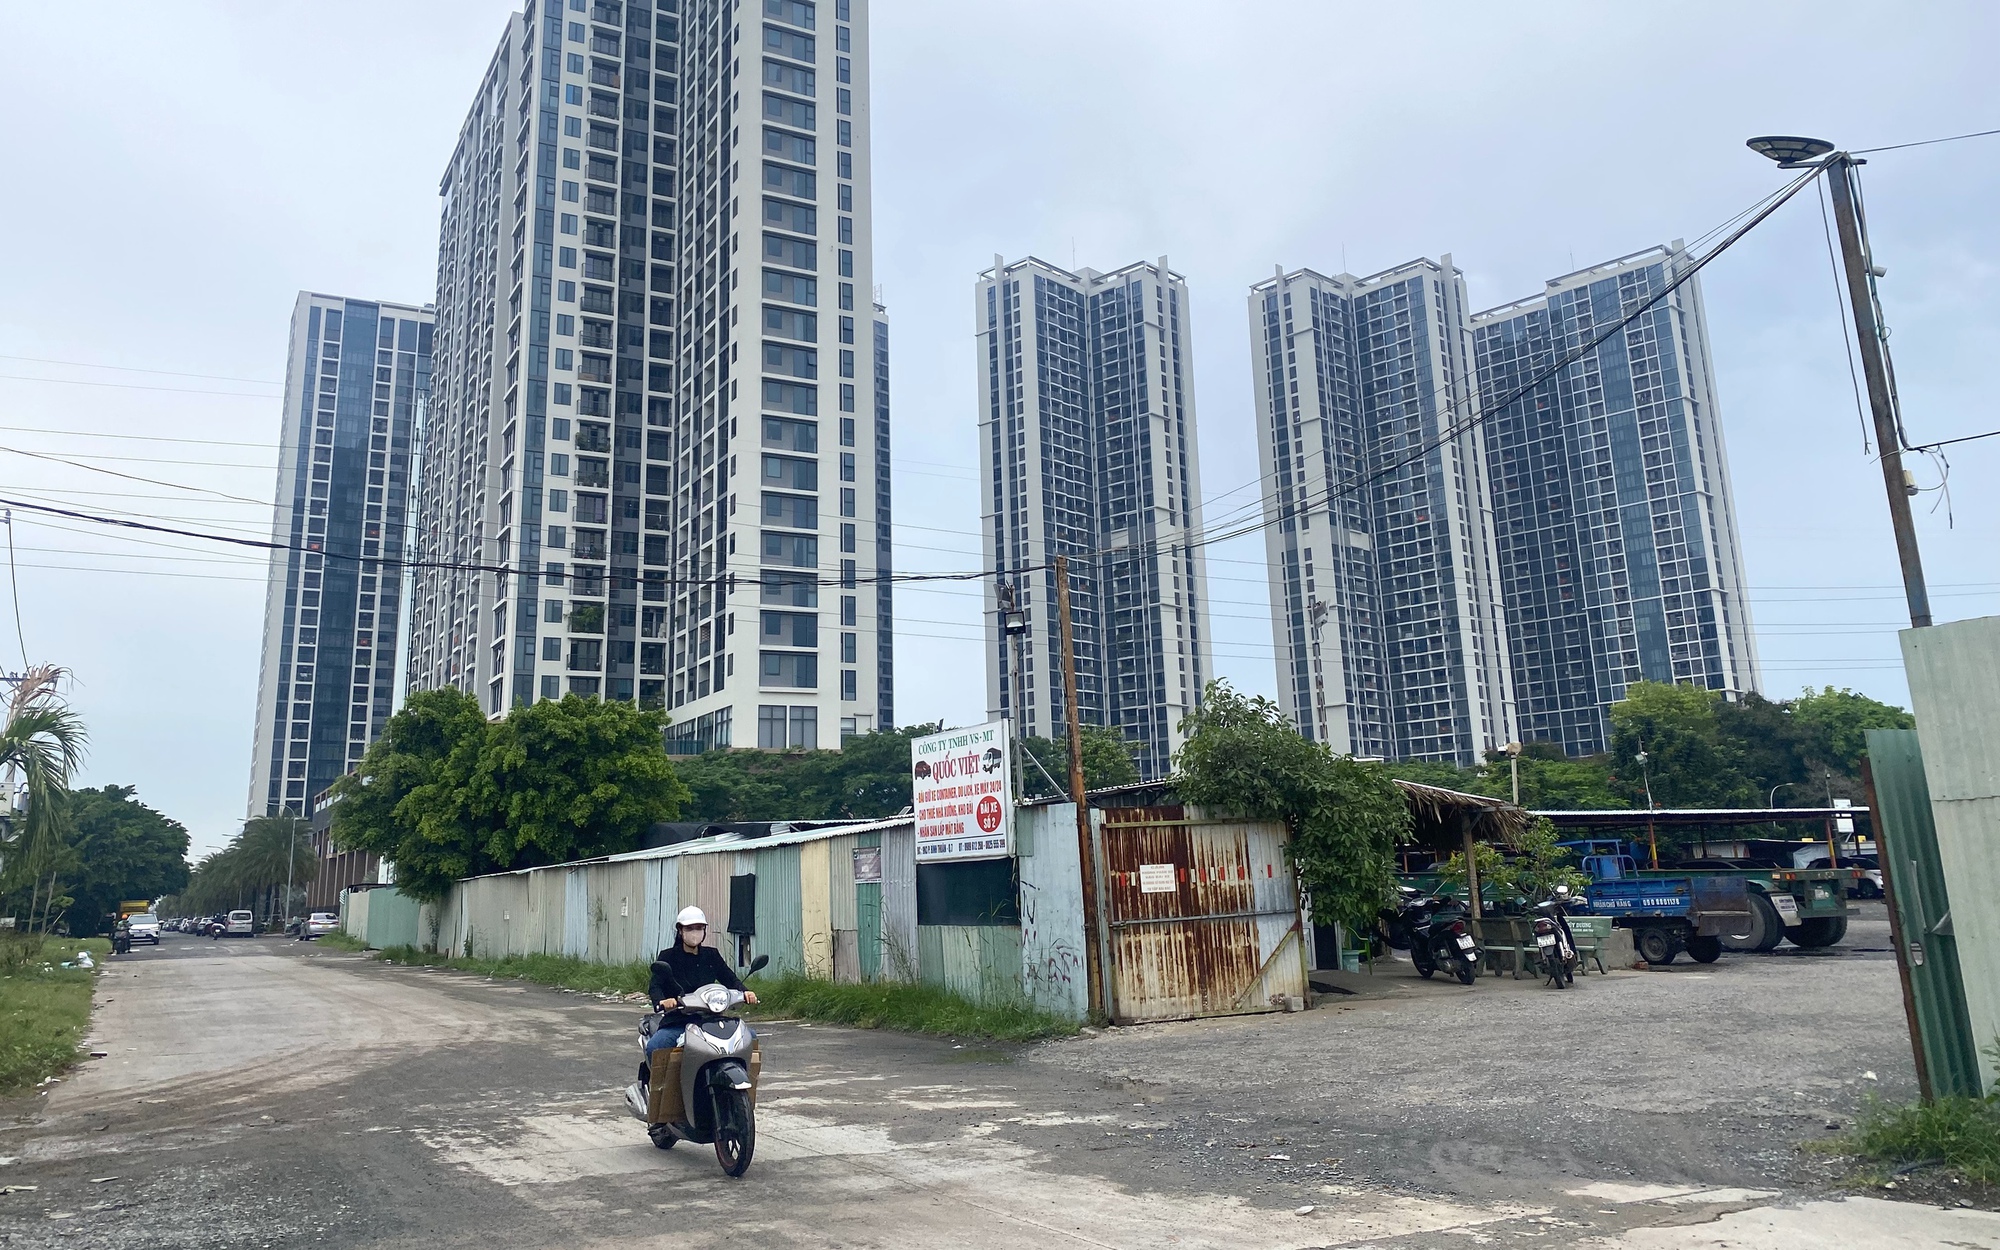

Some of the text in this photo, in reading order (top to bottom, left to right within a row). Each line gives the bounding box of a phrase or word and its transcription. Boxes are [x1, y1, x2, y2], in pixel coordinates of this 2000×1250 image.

[938, 739, 947, 752] TY
[947, 735, 968, 750] TNHH
[932, 750, 980, 784] QUỐC VIỆT
[990, 802, 998, 813] XE
[983, 814, 996, 829] SỐ 2
